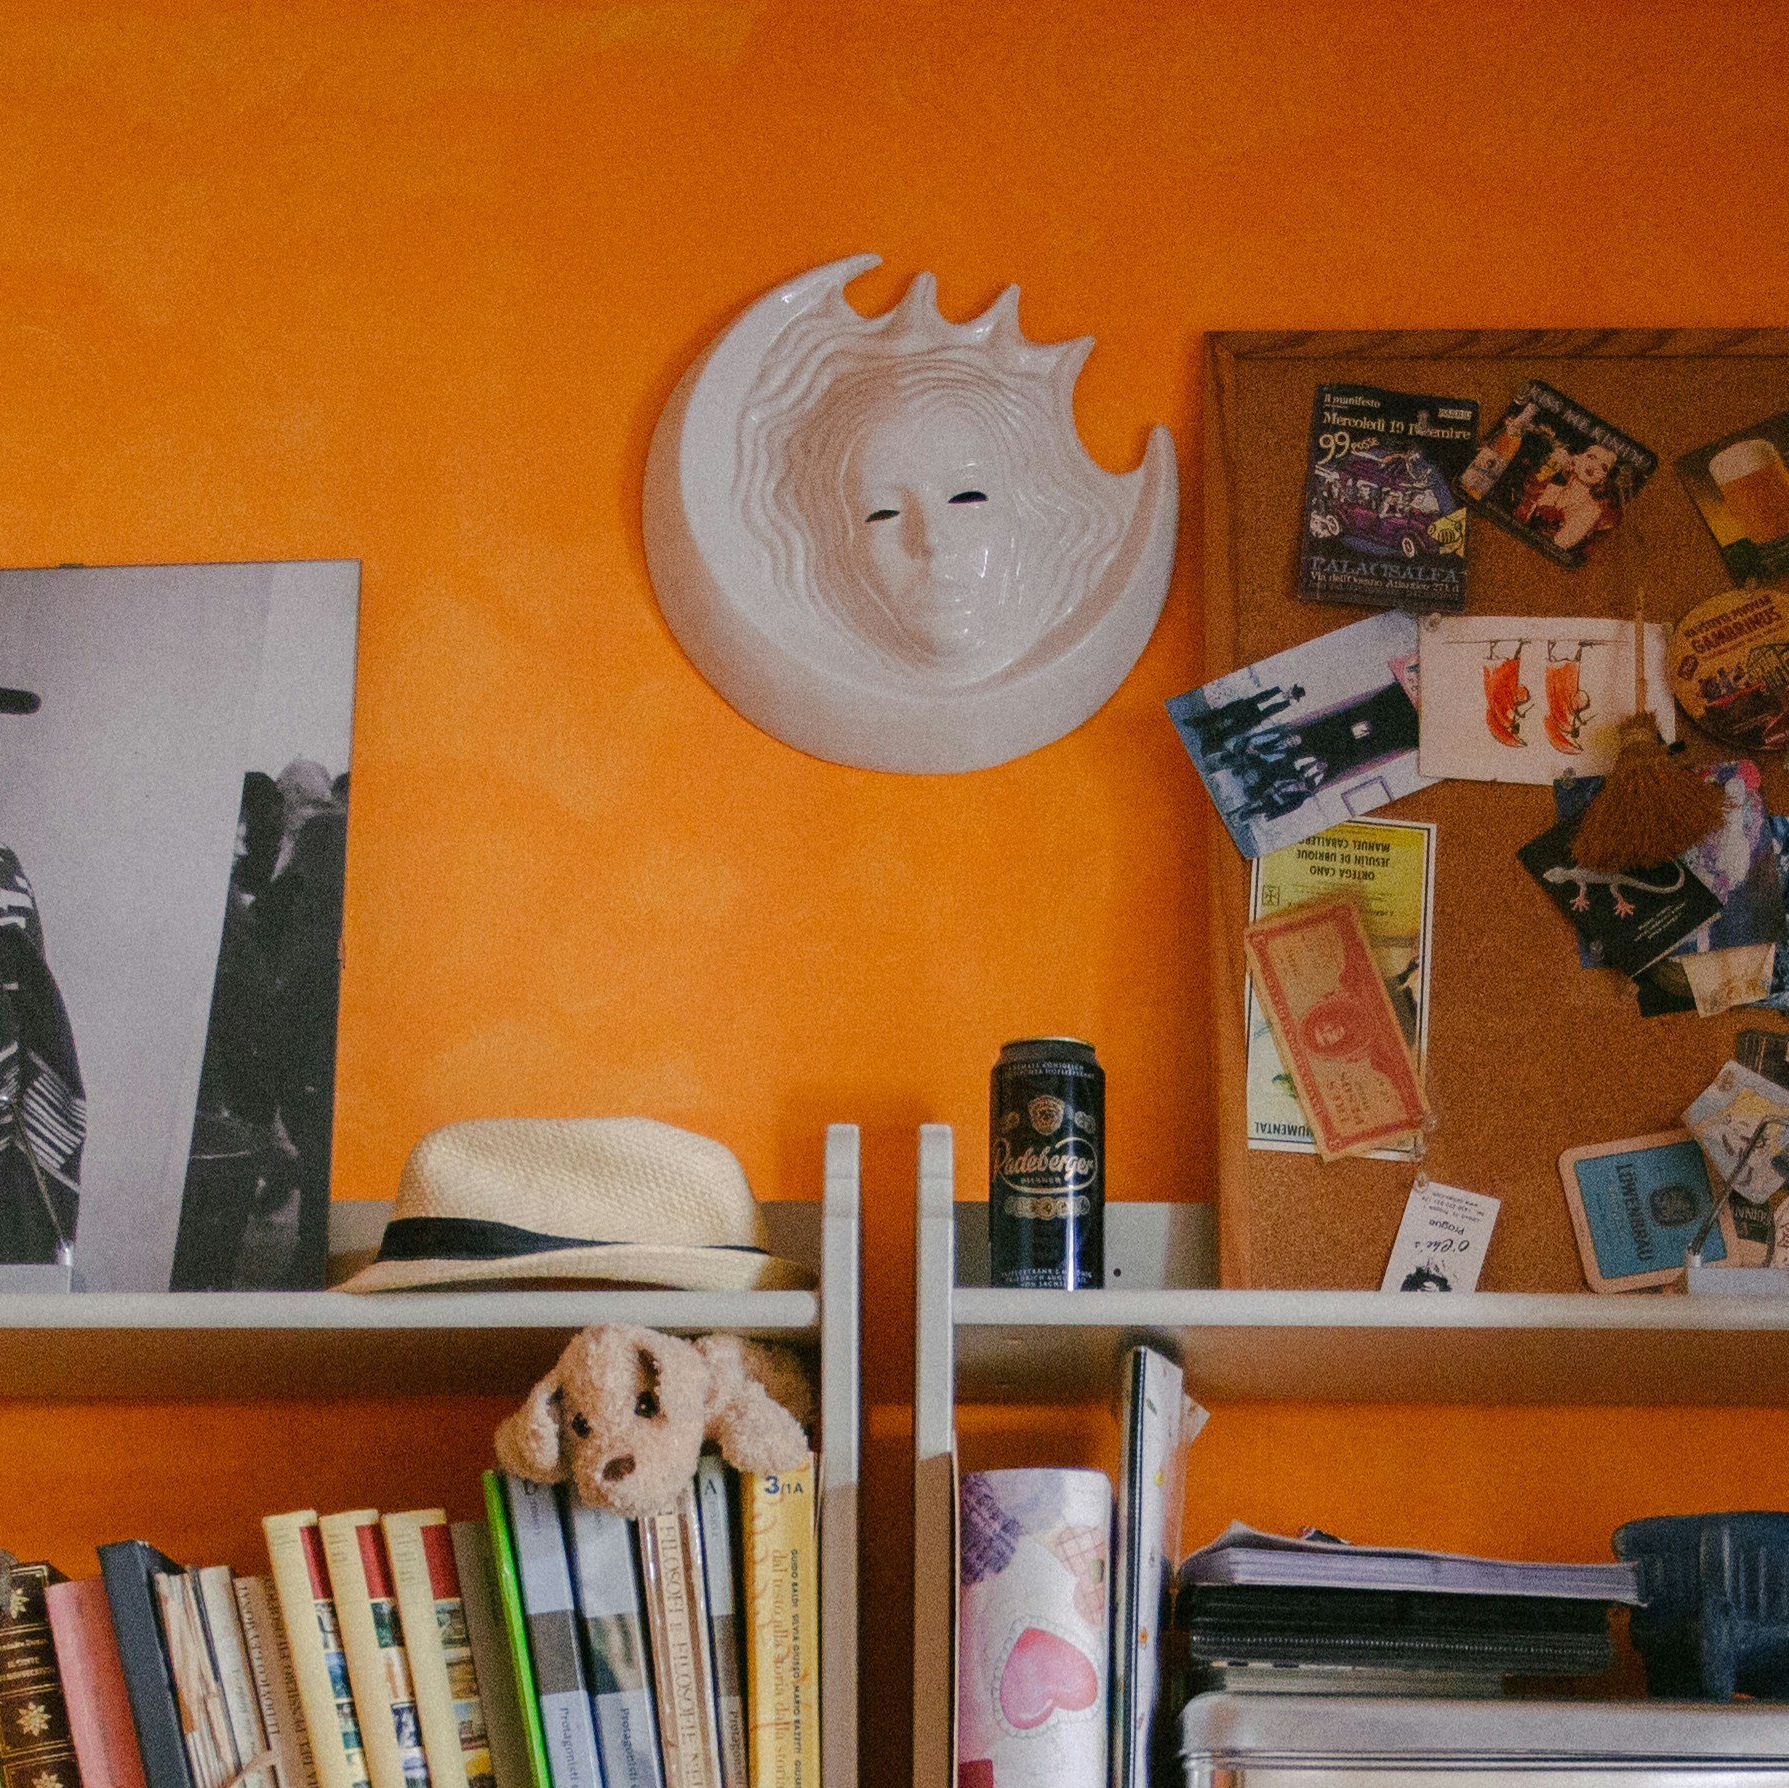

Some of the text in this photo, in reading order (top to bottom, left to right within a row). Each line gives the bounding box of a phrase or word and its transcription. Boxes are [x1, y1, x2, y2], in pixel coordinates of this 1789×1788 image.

[1318, 431, 1350, 465] 99
[1691, 606, 1782, 654] GAMBRINUS
[1310, 865, 1336, 878] CANO
[1339, 853, 1351, 863] DE
[1339, 868, 1375, 881] ORTEGA
[992, 1138, 1094, 1181] Radeberger
[558, 1707, 580, 1782] Protagonisti
[617, 1709, 637, 1782] Protagonisti
